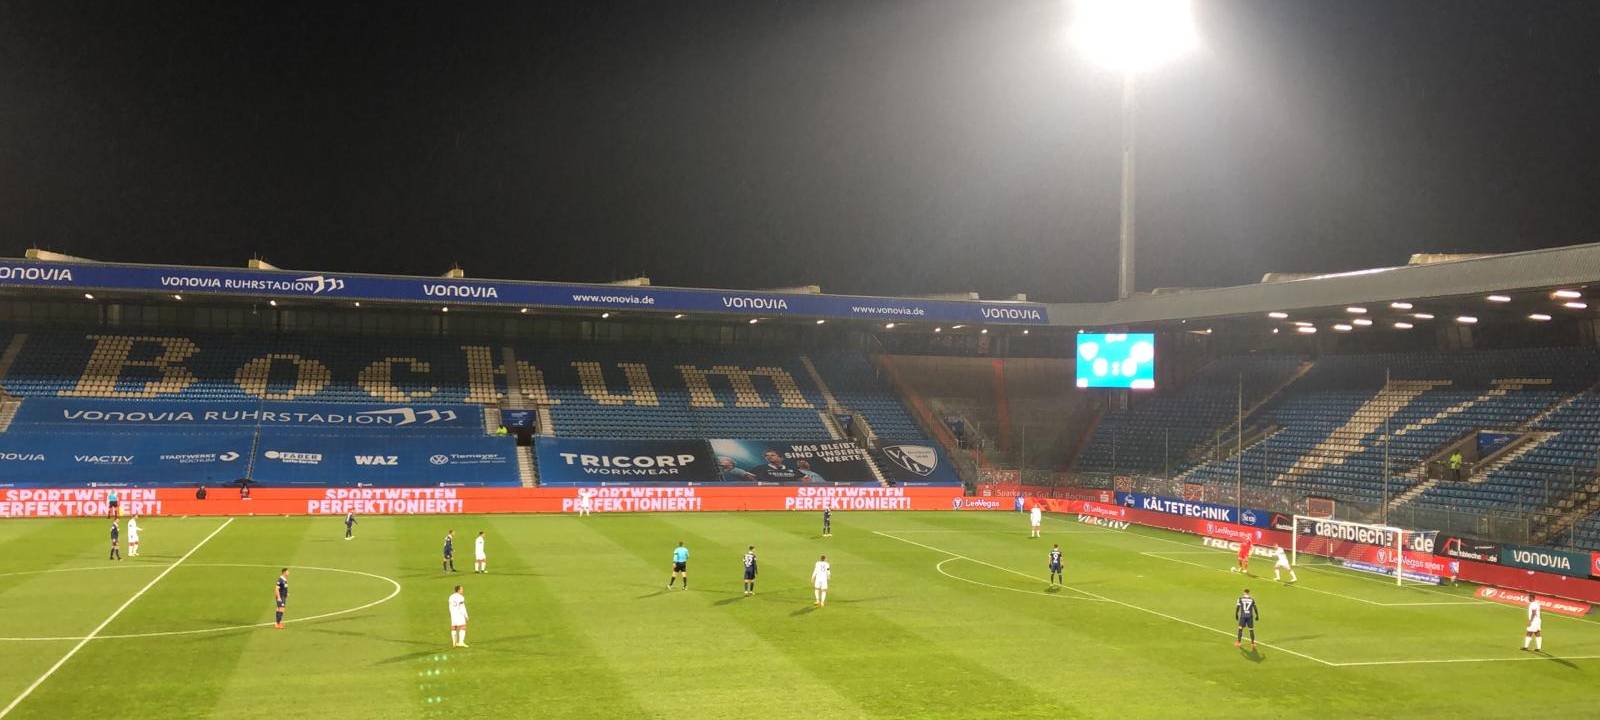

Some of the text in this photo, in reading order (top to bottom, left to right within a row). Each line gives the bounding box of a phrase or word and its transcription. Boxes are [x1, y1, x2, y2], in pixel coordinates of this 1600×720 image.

[160, 276, 315, 292] VONOVIA RUHRSTADION
[423, 284, 498, 299] VONOVIA
[572, 294, 655, 305] www.vonovia.de
[722, 297, 788, 310] VONOVIA
[851, 305, 925, 316] www.vonovia.de
[981, 307, 1041, 320] VONOVIA
[58, 334, 814, 408] Bochum
[63, 409, 393, 425] VONOVIA RUHRSTADION
[74, 454, 135, 463] VIACTIV
[354, 455, 399, 465] WAZ
[559, 452, 696, 468] TRICORP
[583, 467, 679, 475] WORKWEAR
[325, 488, 457, 499] SPORTWETTEN
[797, 487, 904, 497] SPORTWETTEN
[307, 500, 464, 513] PERFEKTIONIERT!
[785, 497, 911, 510] PERFEKTIONIERT!
[965, 499, 1000, 508] LeoVegas
[1143, 497, 1231, 521] KÄLTETECHNIK
[1202, 536, 1279, 558] TRICRP
[1053, 553, 1059, 561] 9
[1513, 549, 1571, 570] VONOVIA
[1242, 601, 1252, 611] 17
